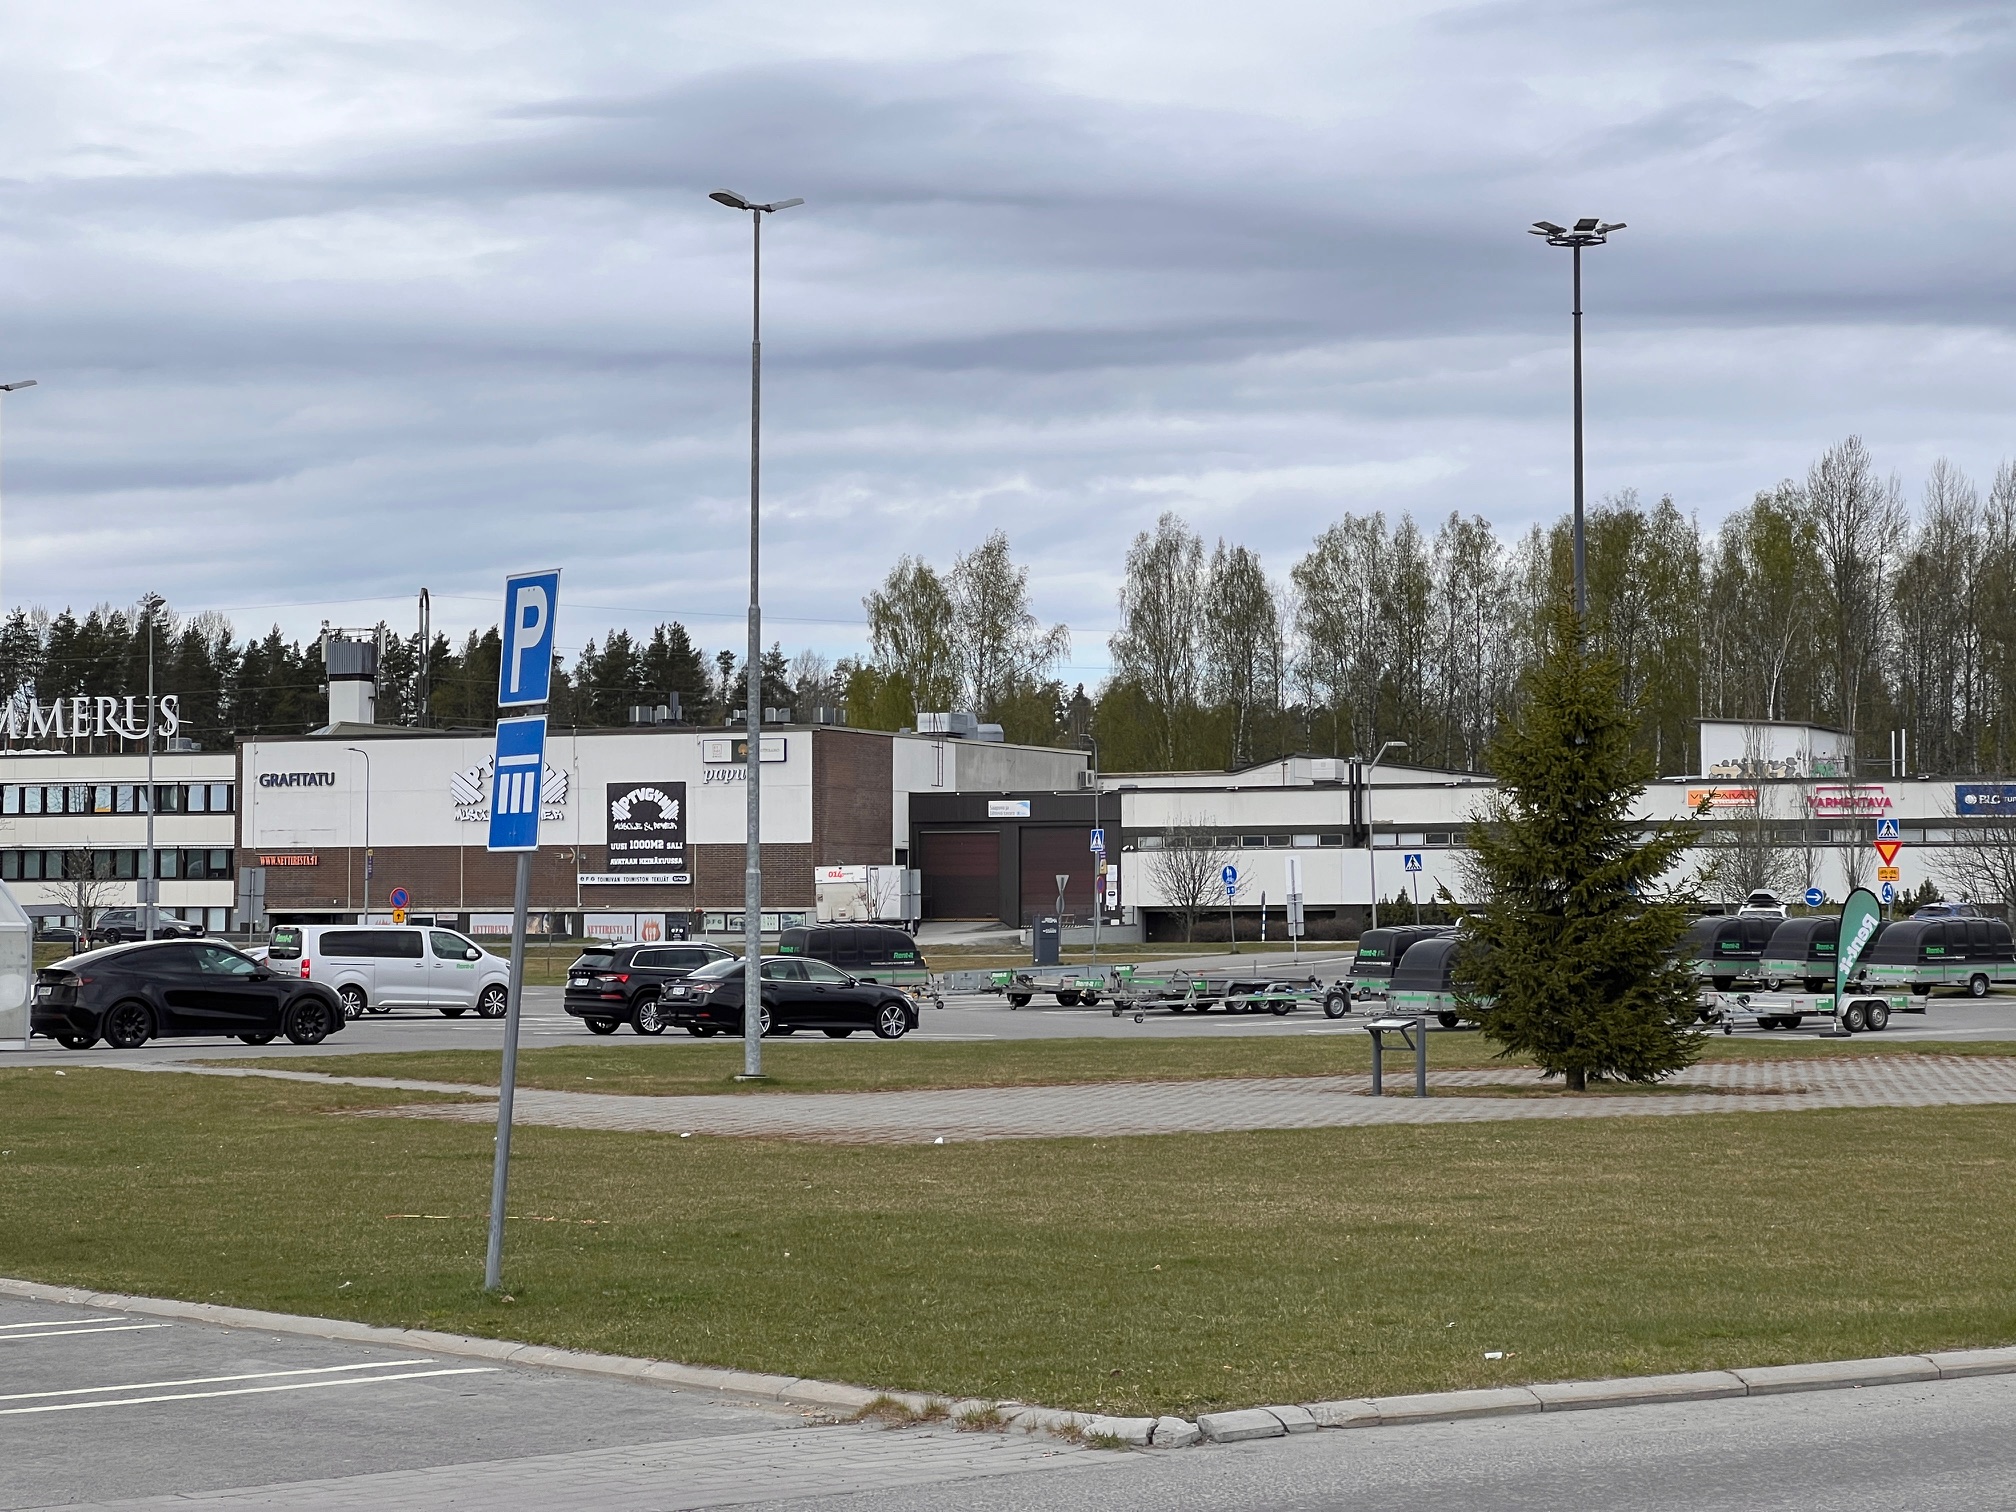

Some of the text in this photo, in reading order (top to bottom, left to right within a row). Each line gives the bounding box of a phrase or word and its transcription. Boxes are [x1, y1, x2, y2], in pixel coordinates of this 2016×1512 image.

[509, 585, 548, 694] P
[259, 772, 336, 788] GRAFITATU
[1806, 796, 1893, 808] VARMENTAVA
[610, 839, 683, 850] UUSI 1000M2 SALI
